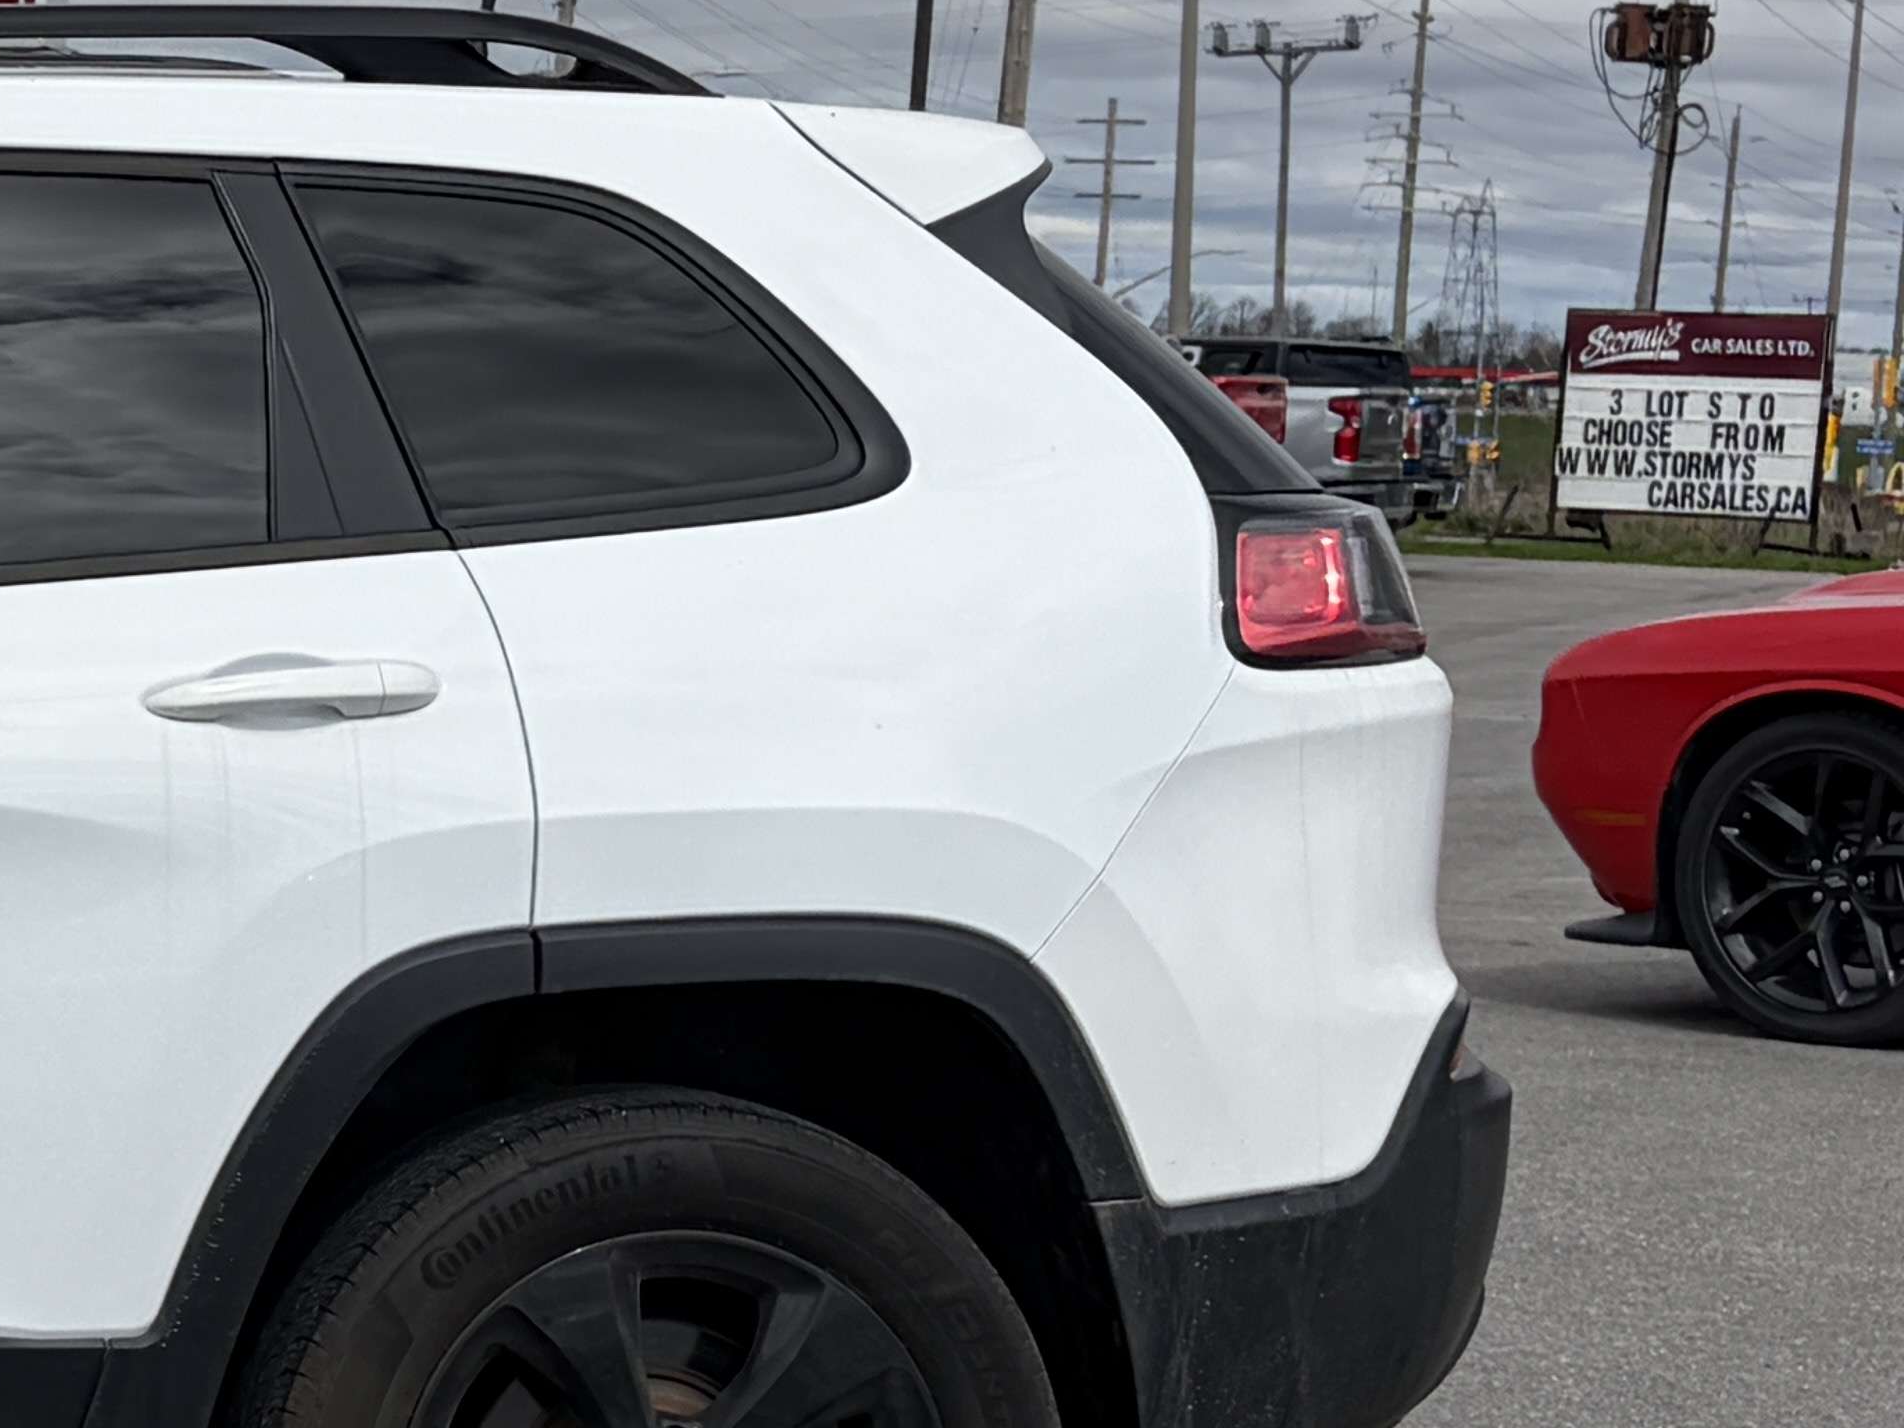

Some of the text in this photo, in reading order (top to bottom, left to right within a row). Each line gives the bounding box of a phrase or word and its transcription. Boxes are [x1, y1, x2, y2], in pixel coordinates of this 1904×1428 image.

[1579, 318, 1815, 362] Stormy's CAR SALES LTD.
[1609, 388, 1624, 416] 3
[1583, 418, 1786, 454] CHOOSE FROM
[1557, 446, 1757, 481] WWW.STORMYS
